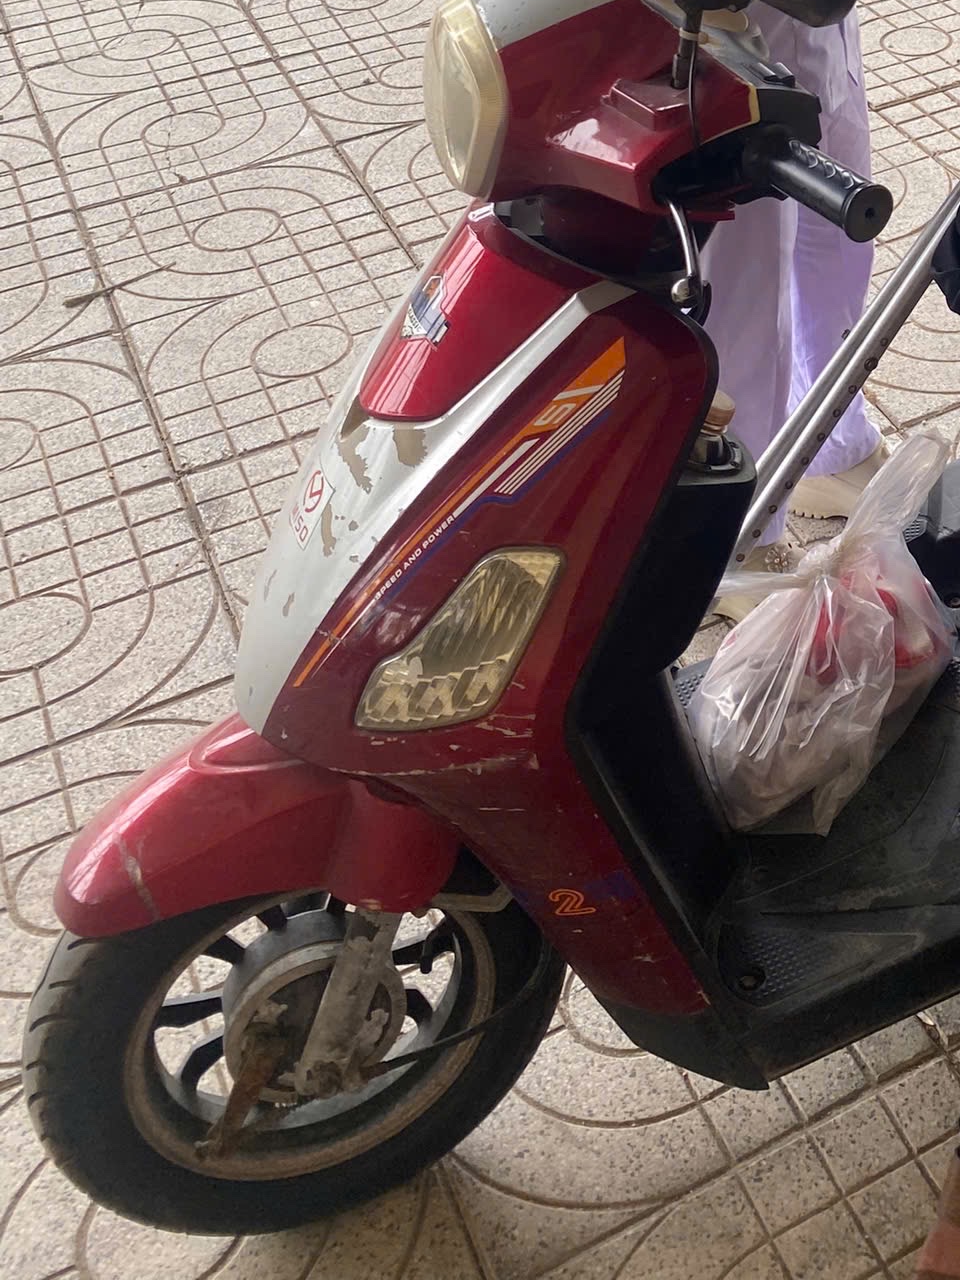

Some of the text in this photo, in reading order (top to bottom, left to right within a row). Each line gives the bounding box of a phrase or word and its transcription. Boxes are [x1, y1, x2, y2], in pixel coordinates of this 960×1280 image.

[375, 515, 454, 601] SPEED AND POWER
